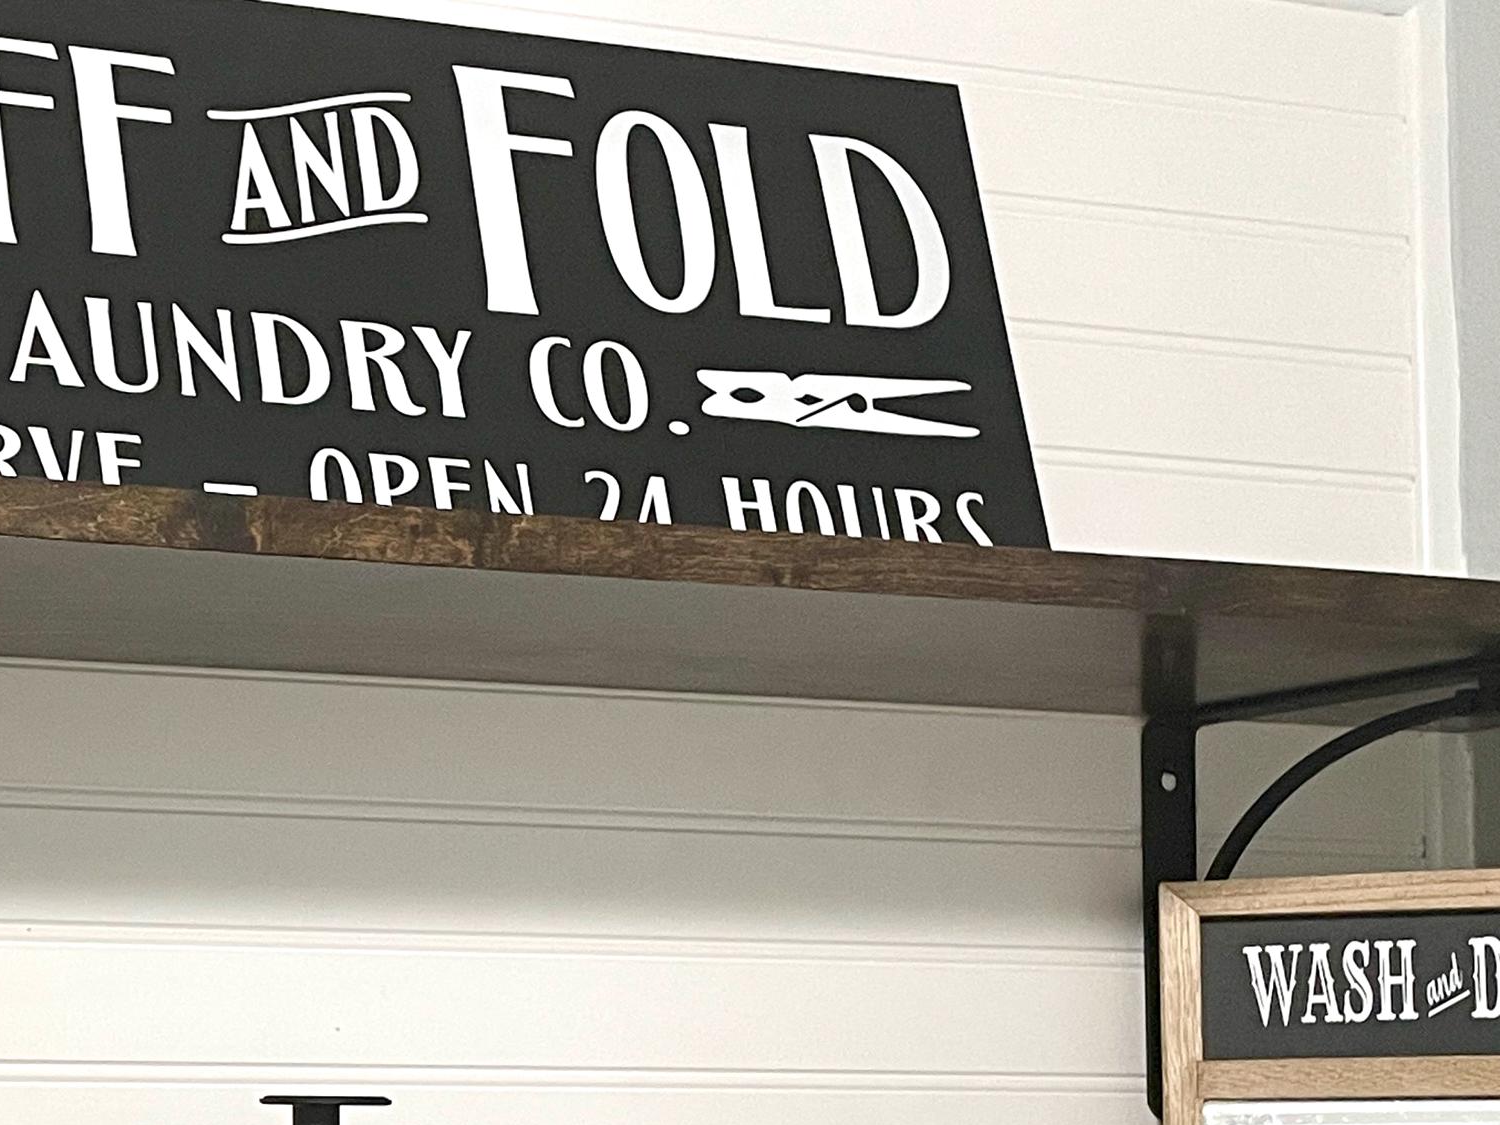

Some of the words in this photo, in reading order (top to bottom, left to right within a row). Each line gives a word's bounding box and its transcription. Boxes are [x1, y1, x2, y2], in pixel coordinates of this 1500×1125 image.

[230, 106, 421, 233] AND
[451, 65, 952, 329] FOLD
[529, 336, 690, 435] CO.
[1242, 939, 1419, 1028] WASH
[1426, 951, 1464, 1007] and
